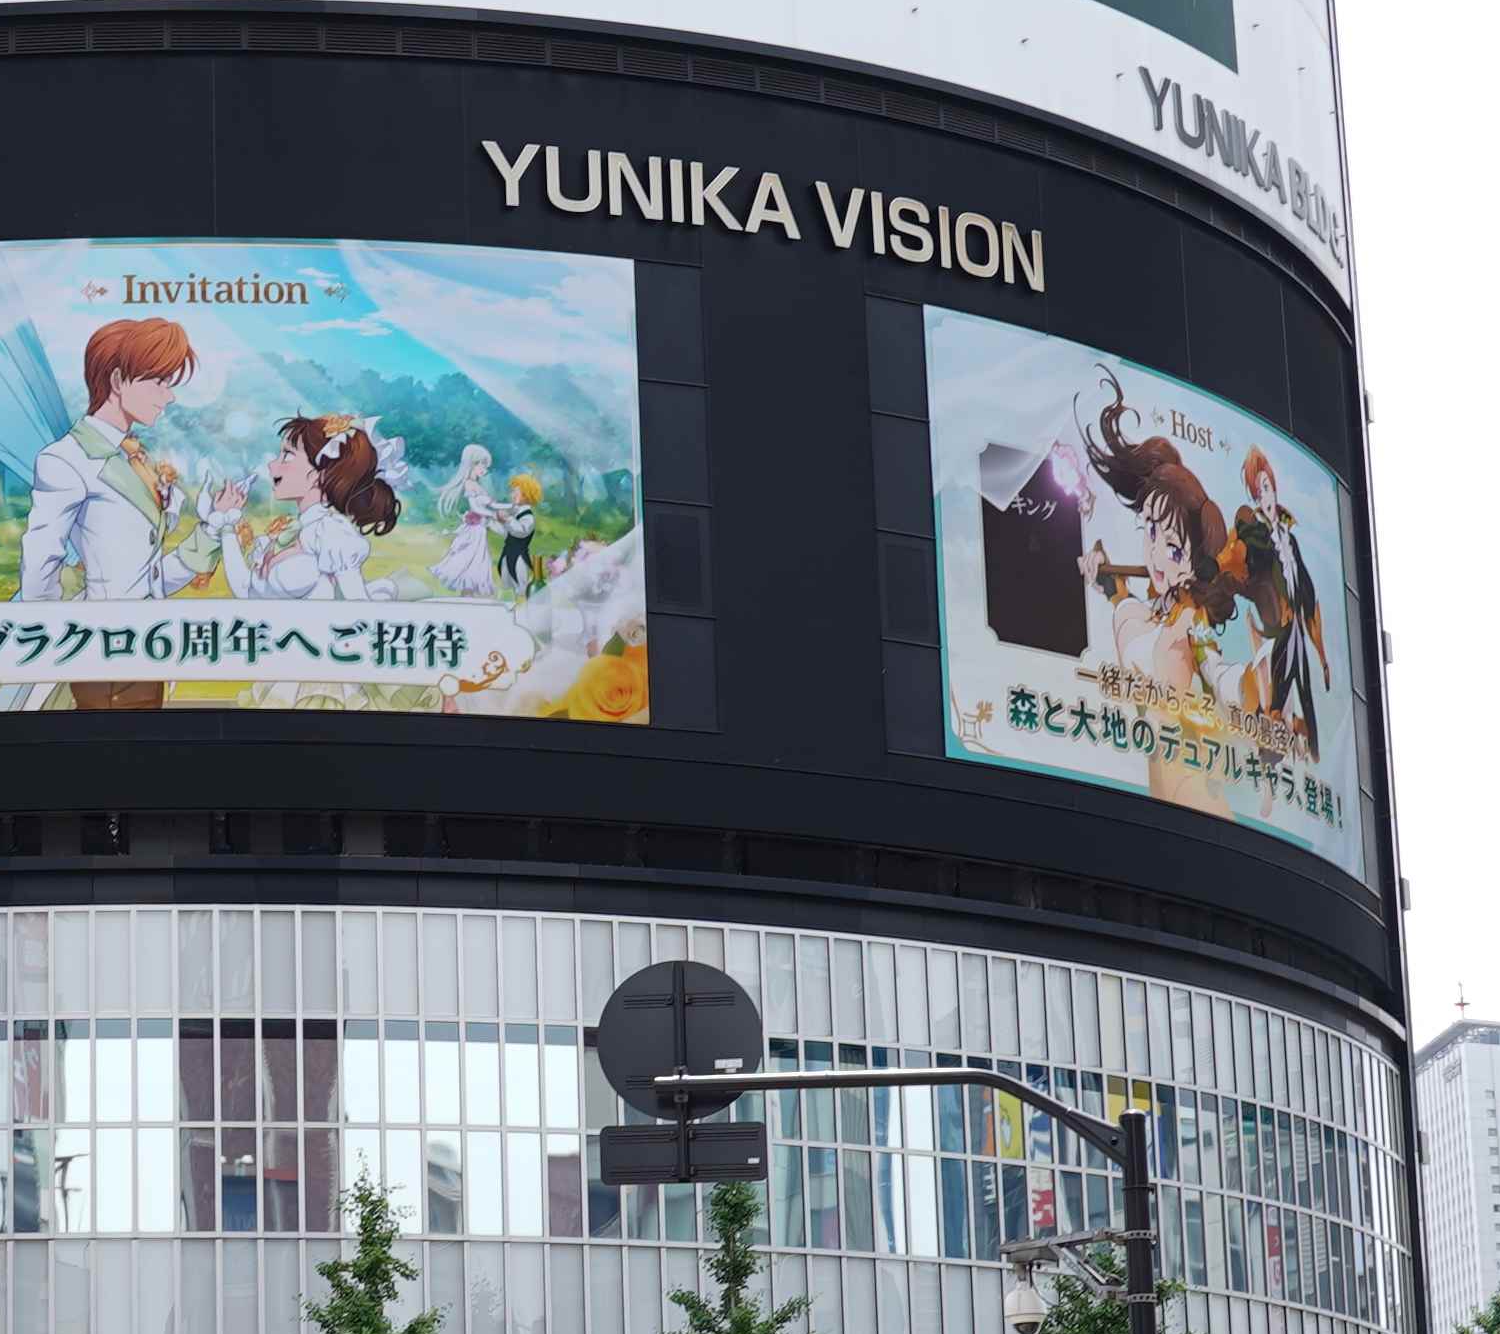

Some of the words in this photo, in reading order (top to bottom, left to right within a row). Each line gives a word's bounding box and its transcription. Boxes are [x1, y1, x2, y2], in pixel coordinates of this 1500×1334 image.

[1138, 65, 1288, 206] YUNIKA
[480, 139, 802, 240] YUNIKA
[815, 180, 1046, 293] VISION
[121, 271, 310, 307] Invitation
[1169, 408, 1215, 453] Host
